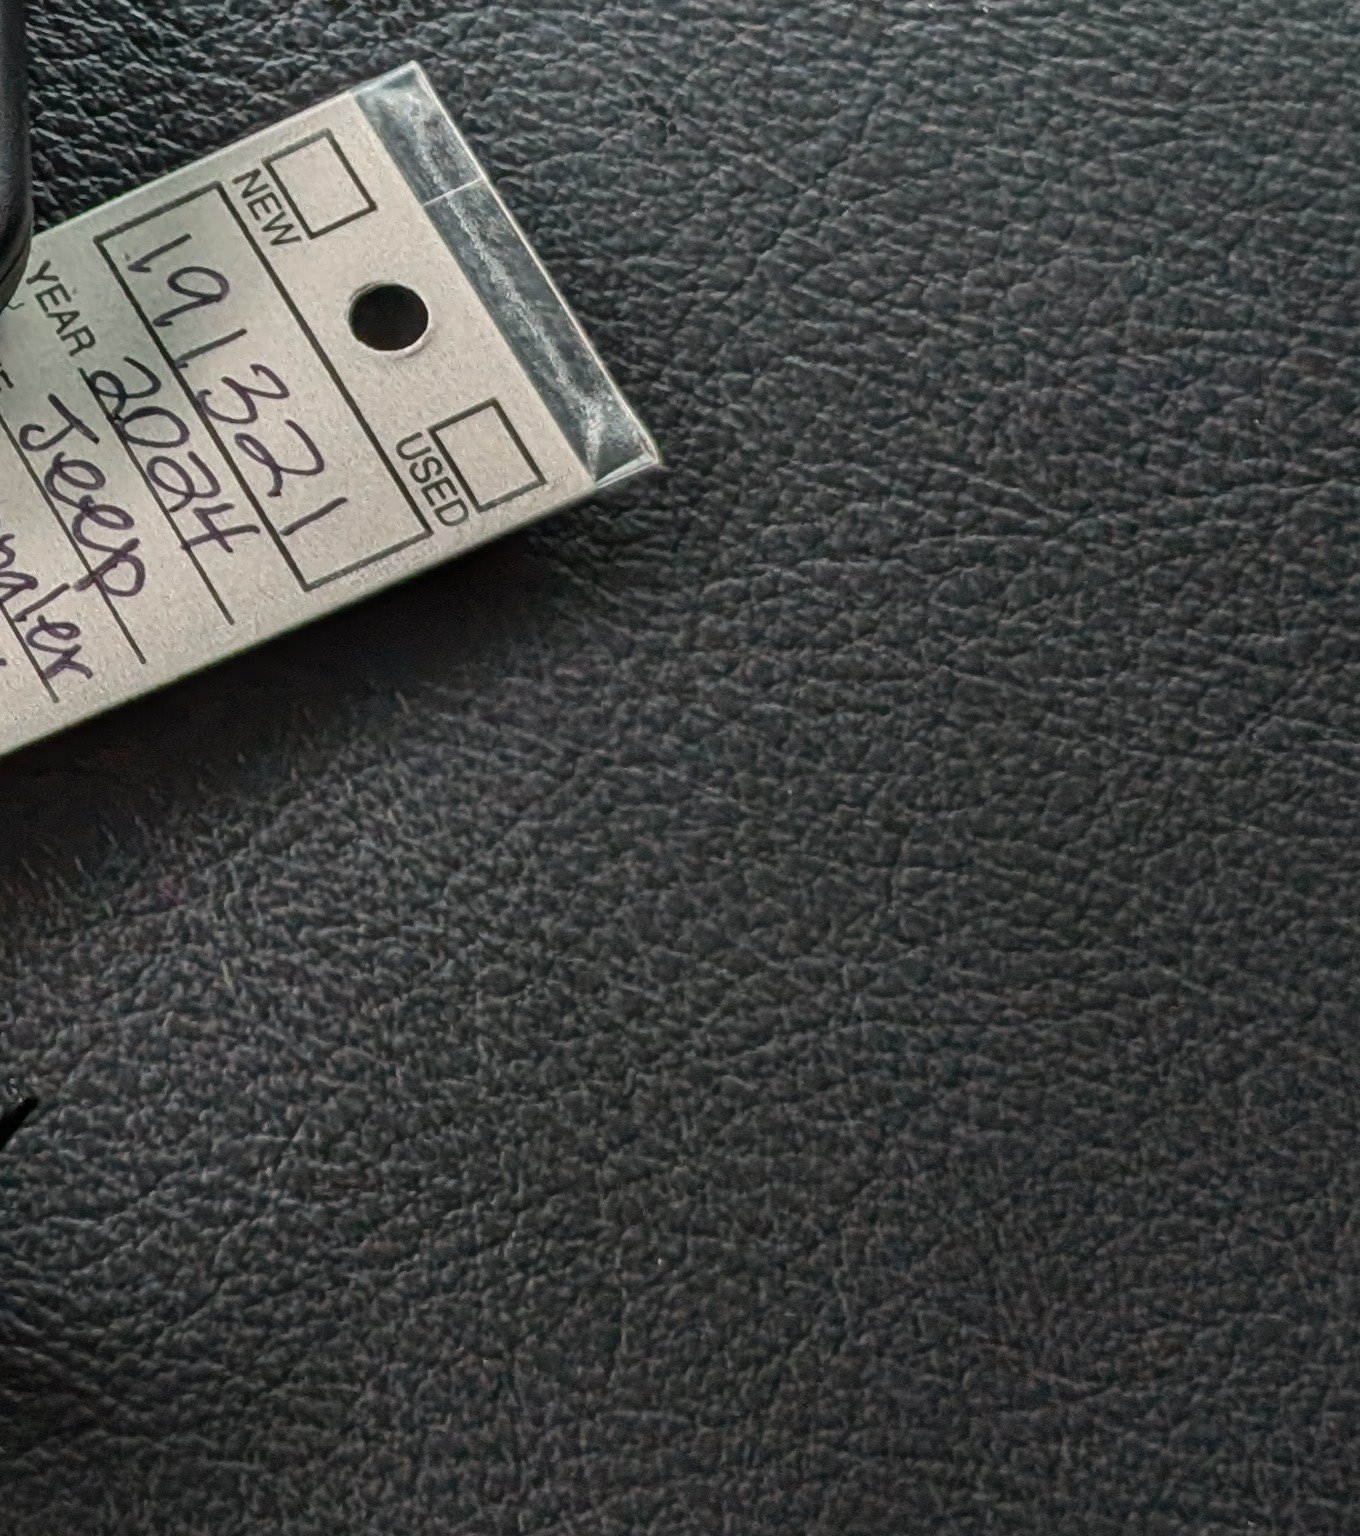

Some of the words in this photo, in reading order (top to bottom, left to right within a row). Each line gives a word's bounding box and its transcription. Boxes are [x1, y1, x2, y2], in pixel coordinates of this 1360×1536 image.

[231, 168, 302, 249] NEW
[25, 259, 98, 359] YEAR
[88, 356, 261, 554] 2024
[124, 233, 348, 536] 191321
[395, 431, 471, 529] USED
[19, 394, 147, 597] Jeep
